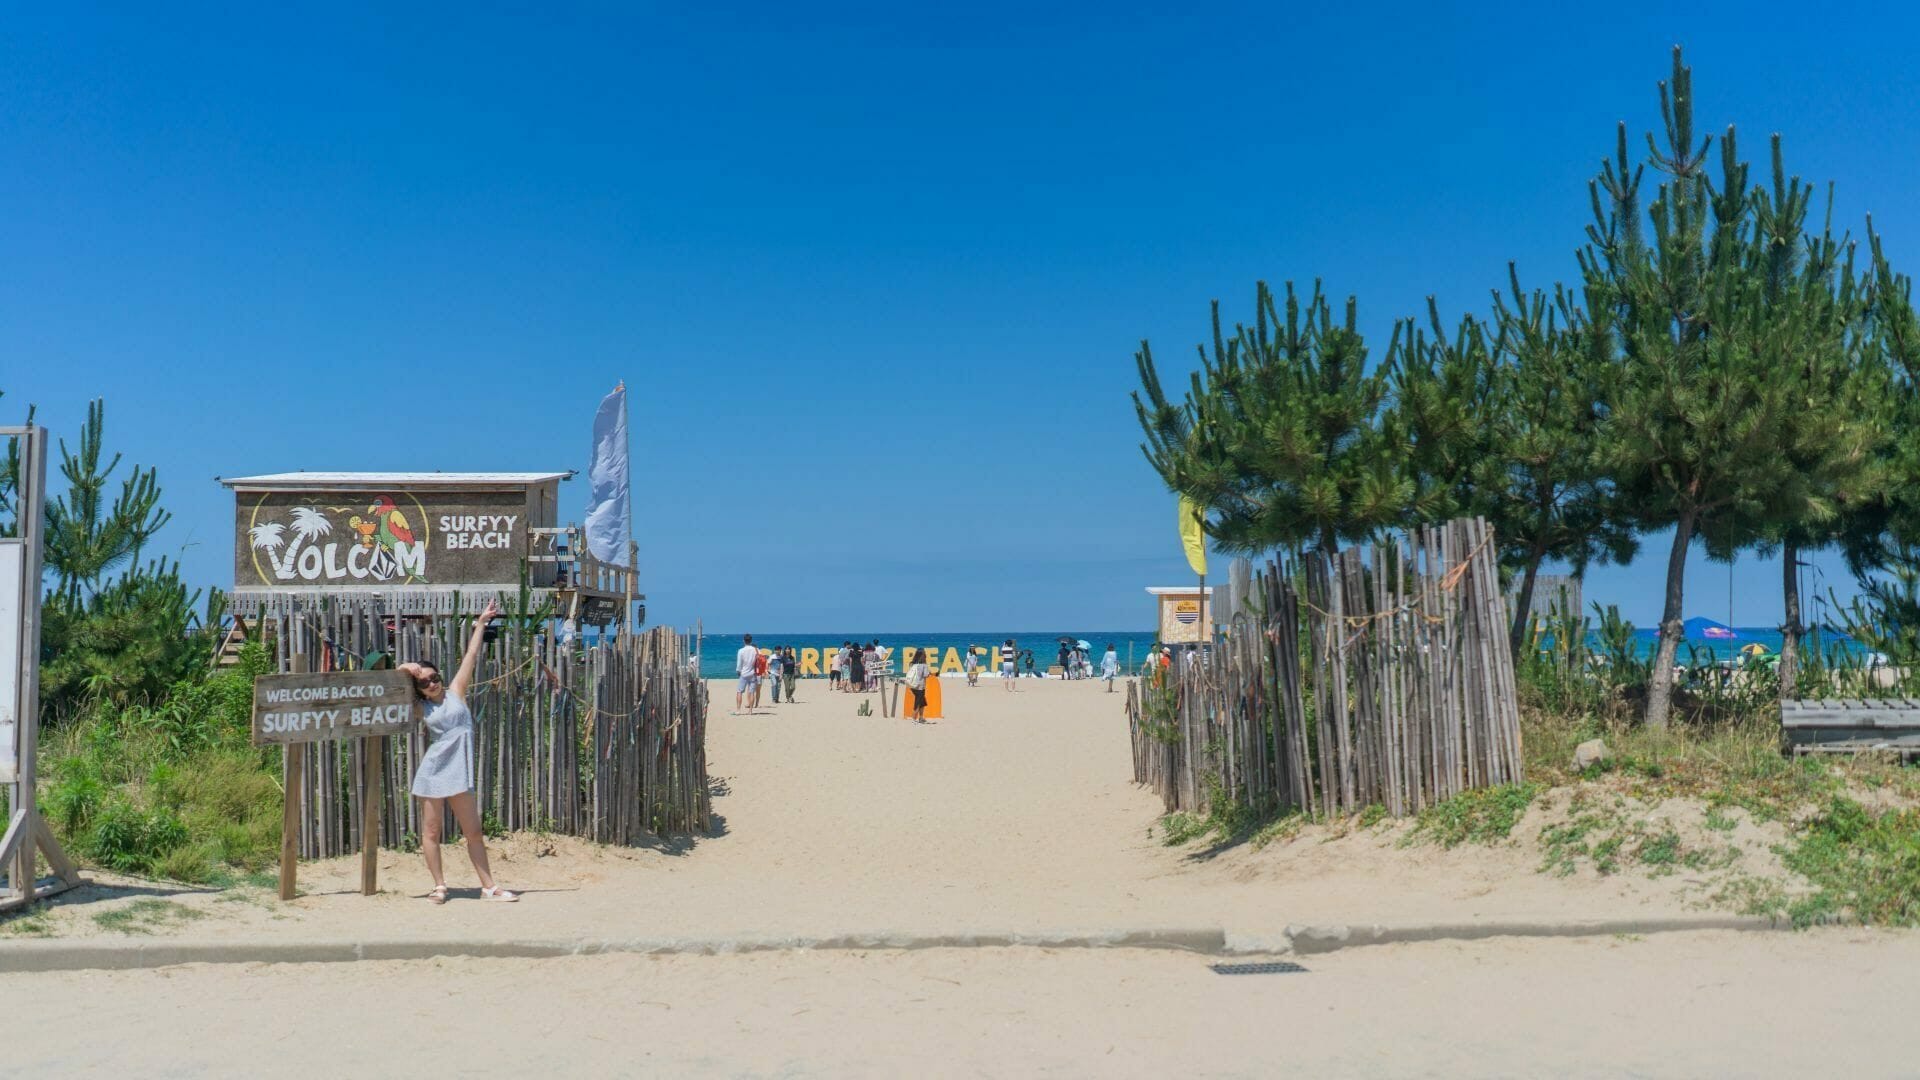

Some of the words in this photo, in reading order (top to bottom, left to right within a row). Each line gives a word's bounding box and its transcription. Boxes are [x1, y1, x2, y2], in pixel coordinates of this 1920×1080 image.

[439, 516, 518, 532] SURFYY
[447, 532, 511, 549] BEACH
[266, 687, 329, 703] WELCOME
[331, 685, 365, 699] BACK
[368, 684, 385, 697] TO
[261, 709, 340, 733] SURFYY
[350, 704, 410, 726] BEACH
